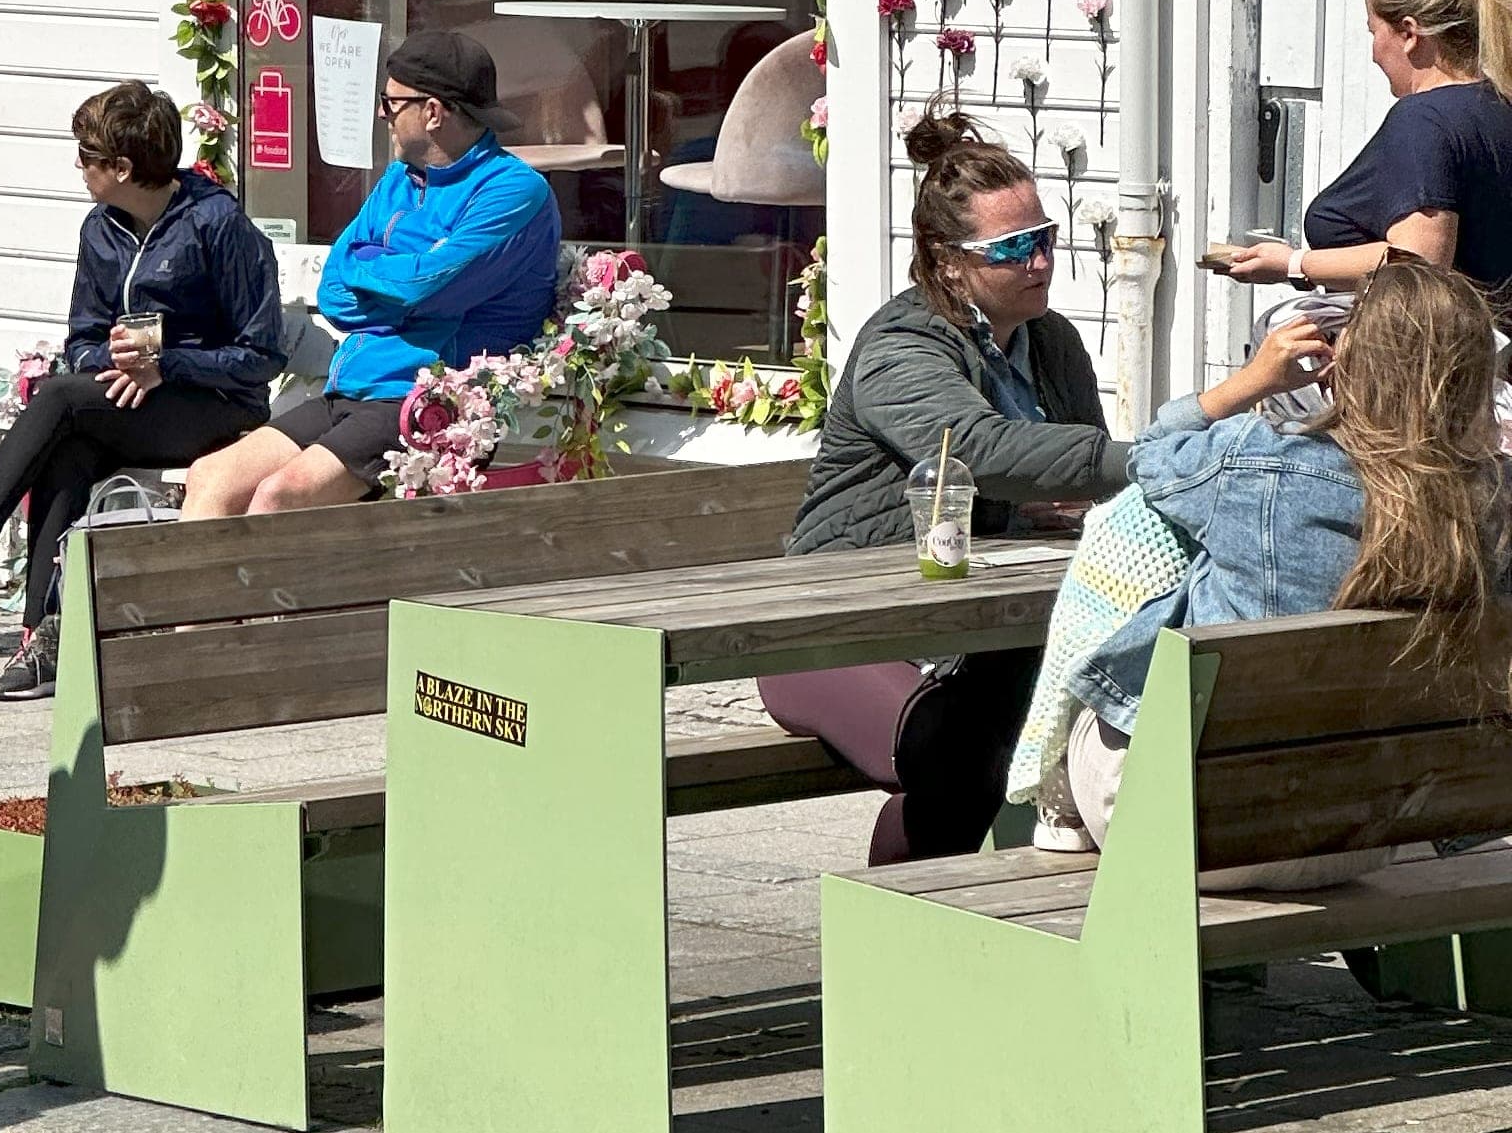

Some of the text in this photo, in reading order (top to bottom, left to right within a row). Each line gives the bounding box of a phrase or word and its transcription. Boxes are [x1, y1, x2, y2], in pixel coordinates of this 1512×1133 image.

[325, 56, 352, 69] OPEN
[415, 692, 526, 743] NORTHERN SKY
[416, 675, 526, 723] A BLAZE IN THE
